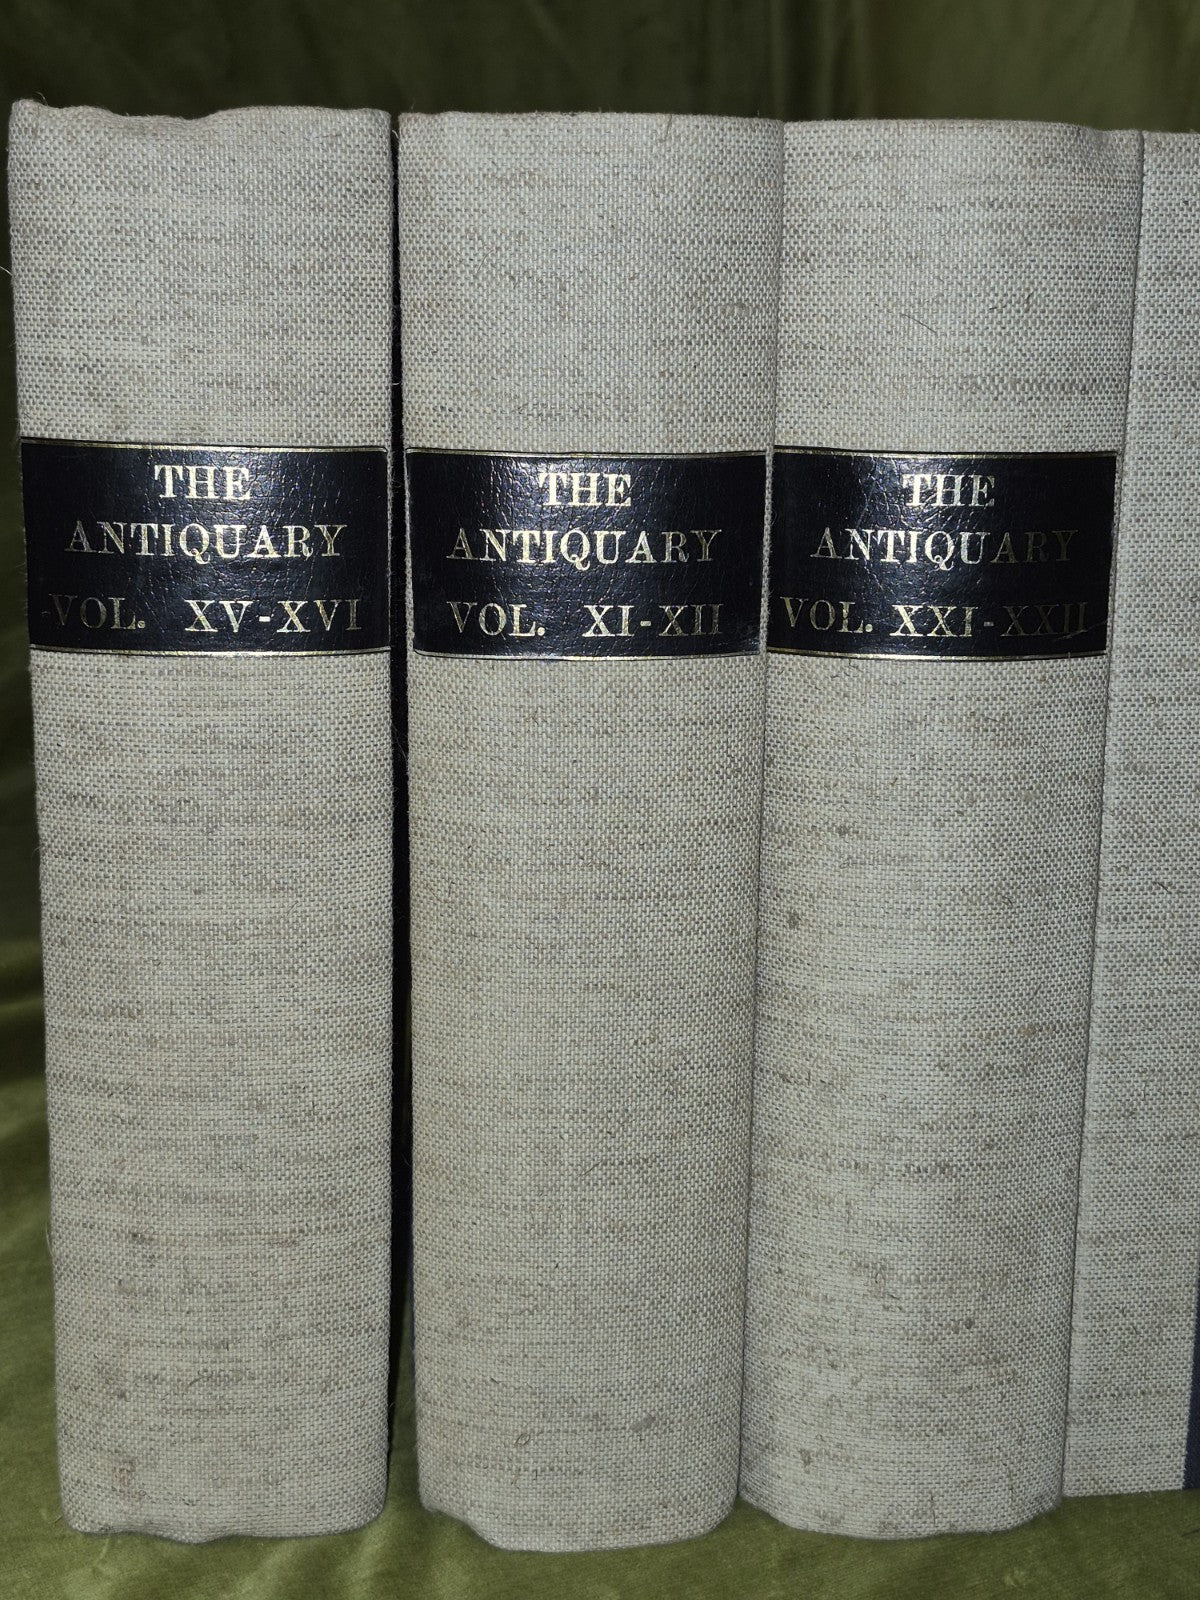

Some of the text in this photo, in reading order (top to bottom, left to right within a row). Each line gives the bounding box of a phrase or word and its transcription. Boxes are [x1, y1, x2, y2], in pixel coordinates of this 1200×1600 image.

[154, 465, 250, 500] THE
[539, 472, 631, 507] THE
[902, 474, 995, 507] THE
[64, 520, 347, 564] ANTIQUARY
[446, 528, 722, 571] ANTIQUARY
[810, 527, 1078, 571] ANTIQUARY
[49, 594, 362, 633] VOL. XV-XVI
[447, 601, 723, 638] VOL. XI-XII
[780, 596, 1087, 638] VOL. XXI-XXII
